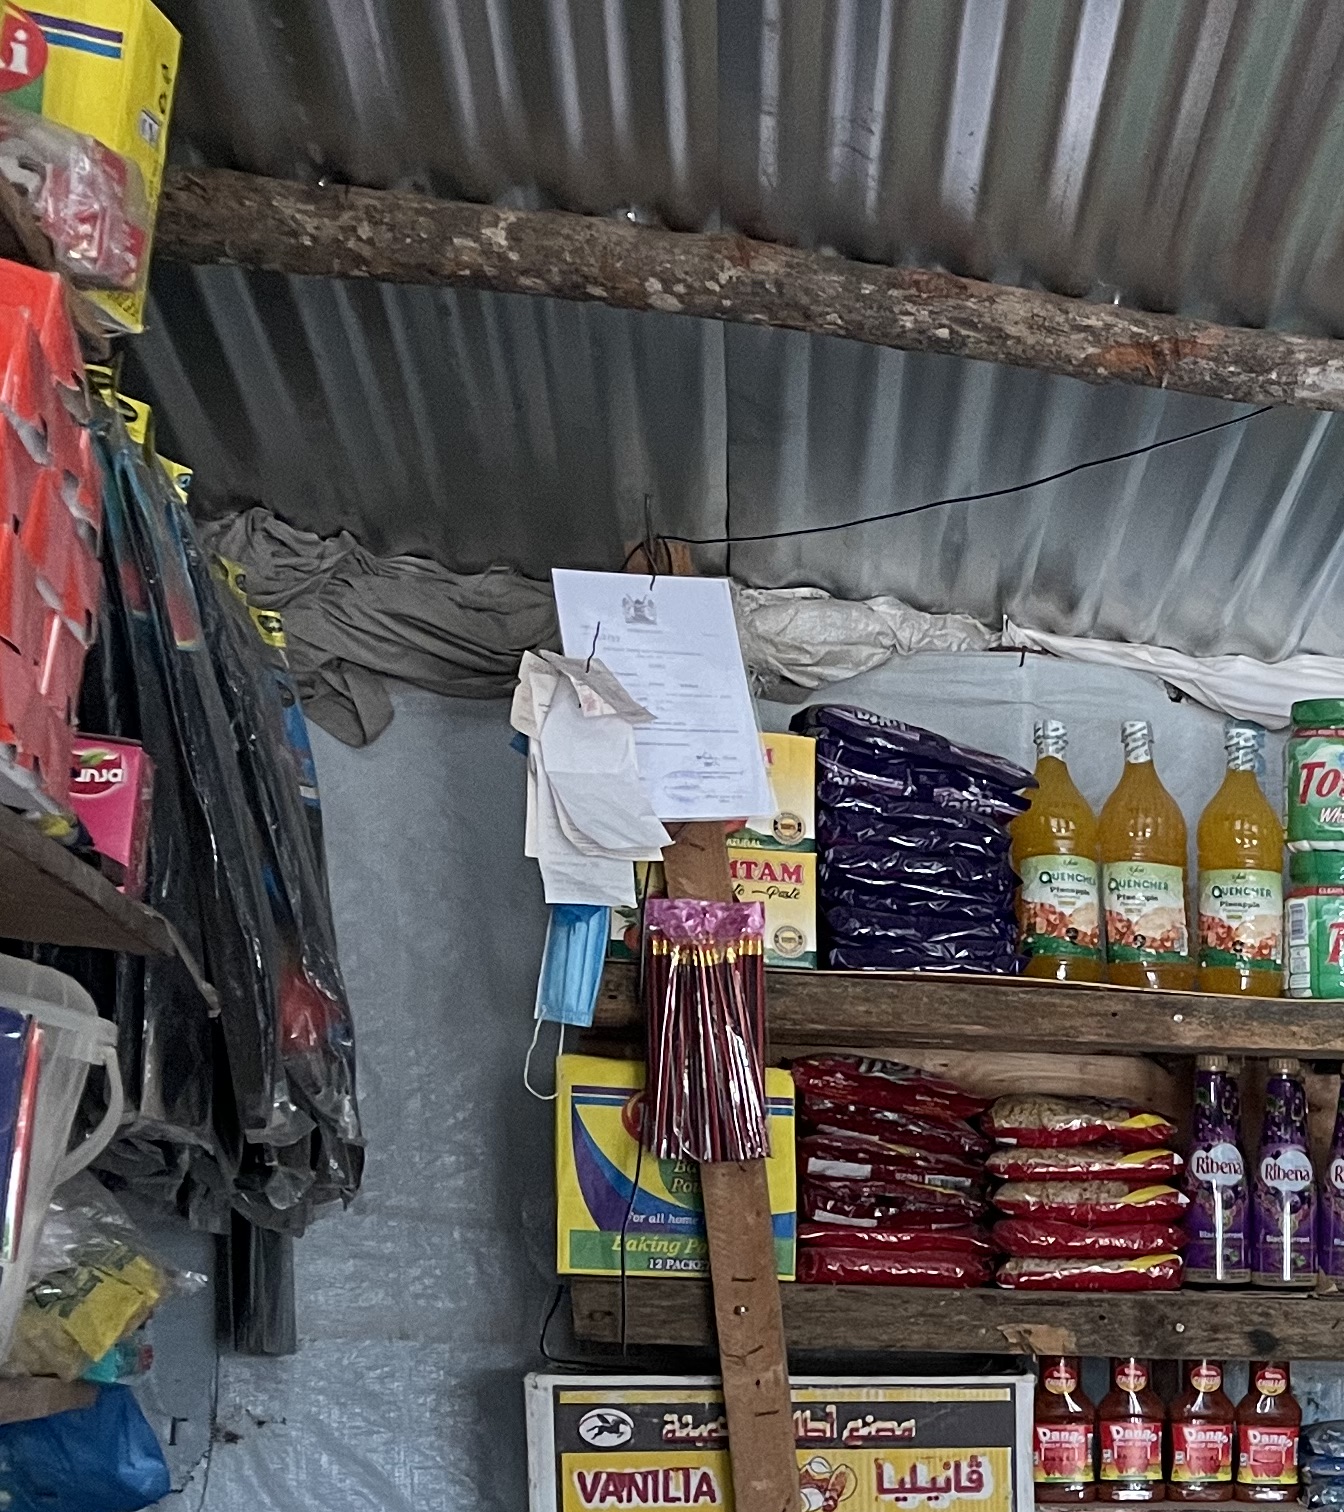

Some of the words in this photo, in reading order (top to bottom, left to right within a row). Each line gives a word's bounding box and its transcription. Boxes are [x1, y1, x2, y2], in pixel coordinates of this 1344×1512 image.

[1211, 885, 1273, 899] QUENCHER
[1195, 1156, 1242, 1175] Ribena
[1264, 1163, 1310, 1182] Ribena
[648, 1212, 664, 1224] all
[649, 1258, 663, 1268] 12
